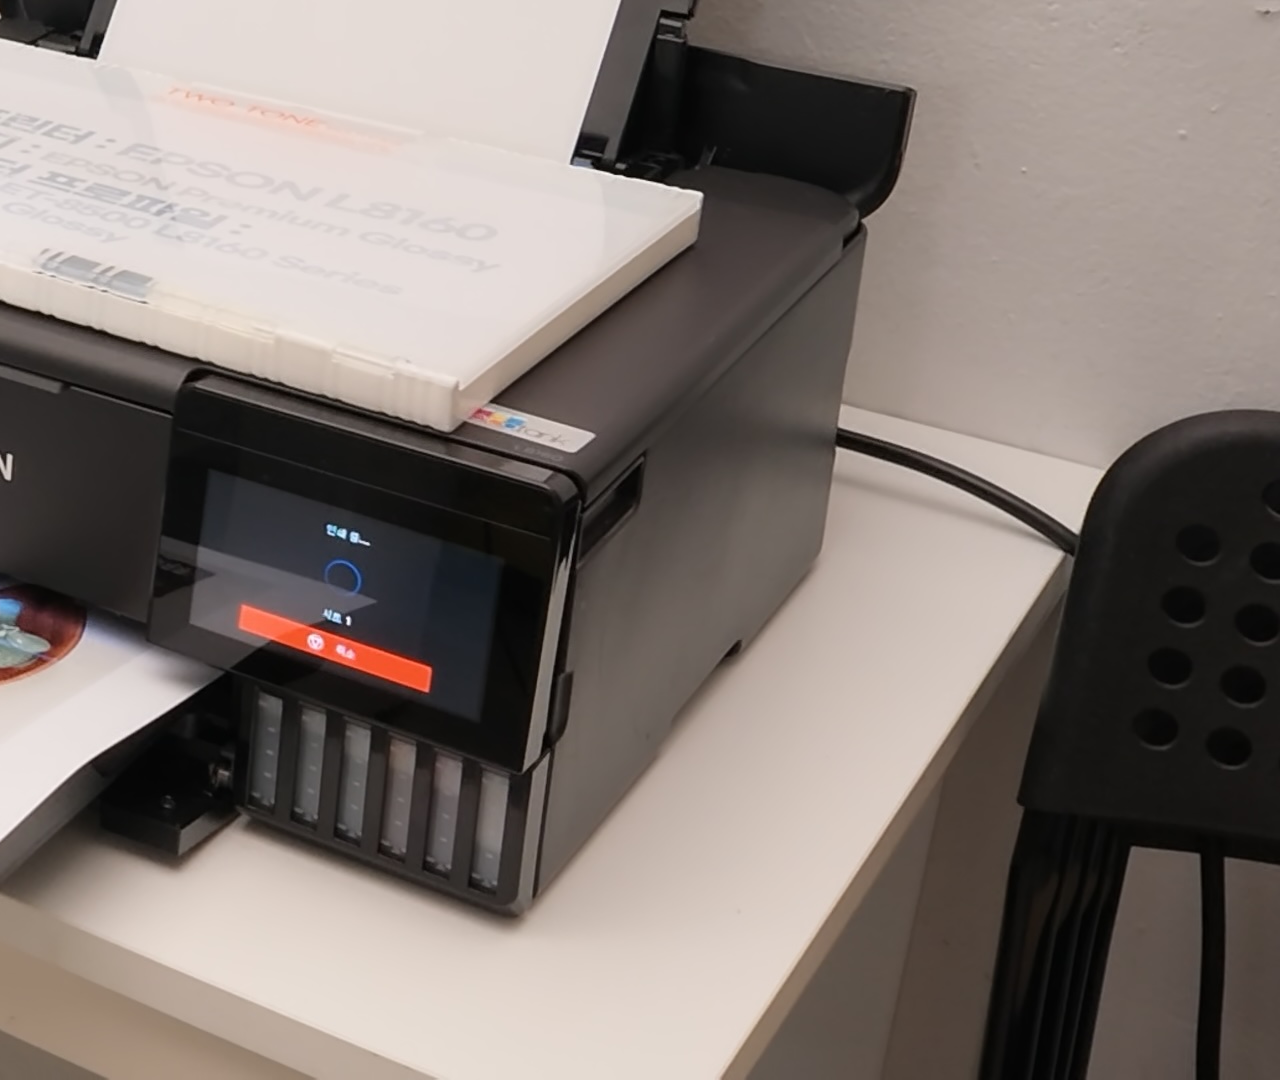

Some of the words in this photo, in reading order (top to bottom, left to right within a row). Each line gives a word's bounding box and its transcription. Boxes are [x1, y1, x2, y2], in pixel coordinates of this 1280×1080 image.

[1, 201, 130, 244] Glossy
[27, 170, 230, 230] 프로파일
[38, 151, 177, 192] EPSON
[175, 186, 352, 237] Premium
[358, 230, 503, 274] Glossy
[115, 141, 325, 202] EPSON
[322, 192, 499, 242] L8160
[152, 223, 270, 261] L8160
[271, 254, 406, 295] Series
